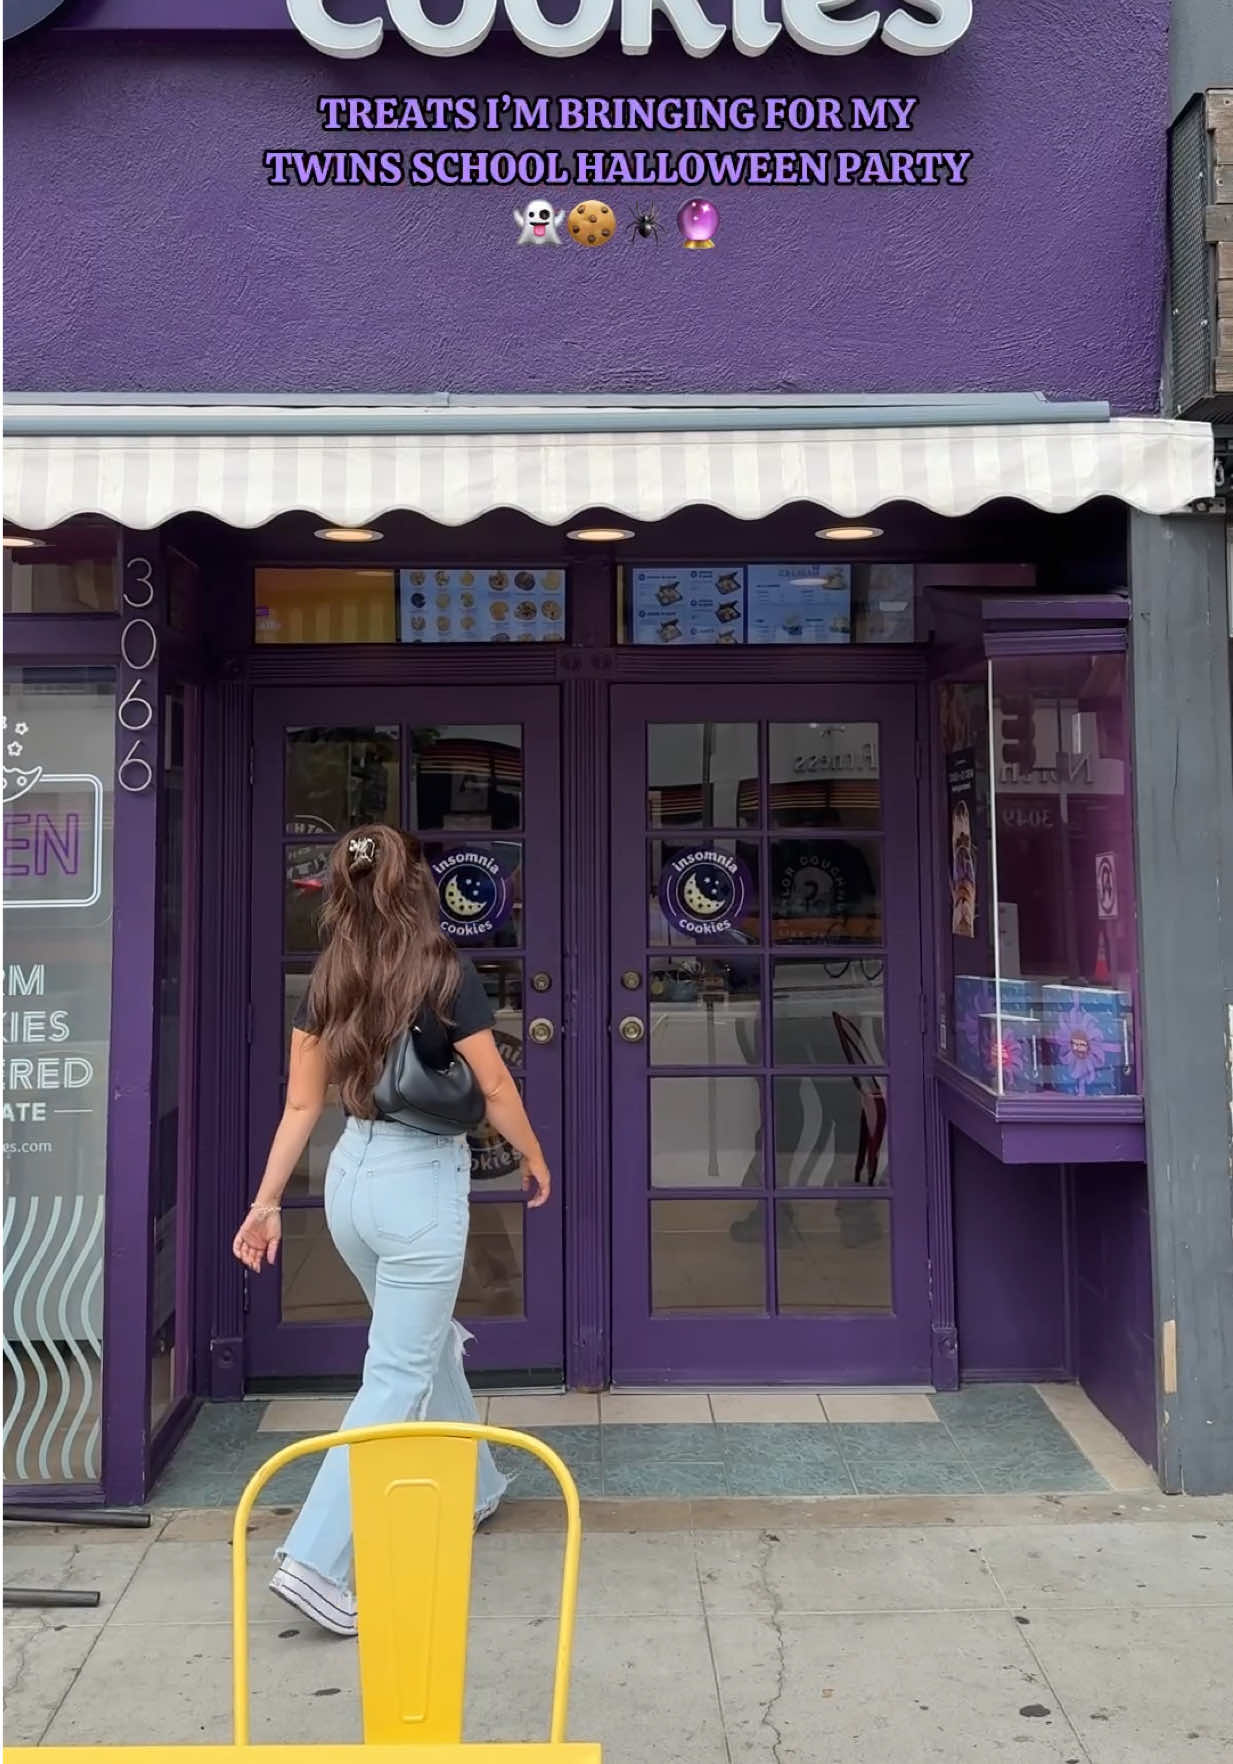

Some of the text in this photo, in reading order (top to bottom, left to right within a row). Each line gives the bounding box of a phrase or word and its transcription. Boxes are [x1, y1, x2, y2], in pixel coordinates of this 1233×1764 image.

[118, 557, 158, 792] 3066
[432, 852, 501, 876] insomnia
[671, 850, 739, 875] insomnia
[439, 919, 495, 937] cookies
[677, 918, 732, 936] cookies
[3, 1057, 94, 1091] RED
